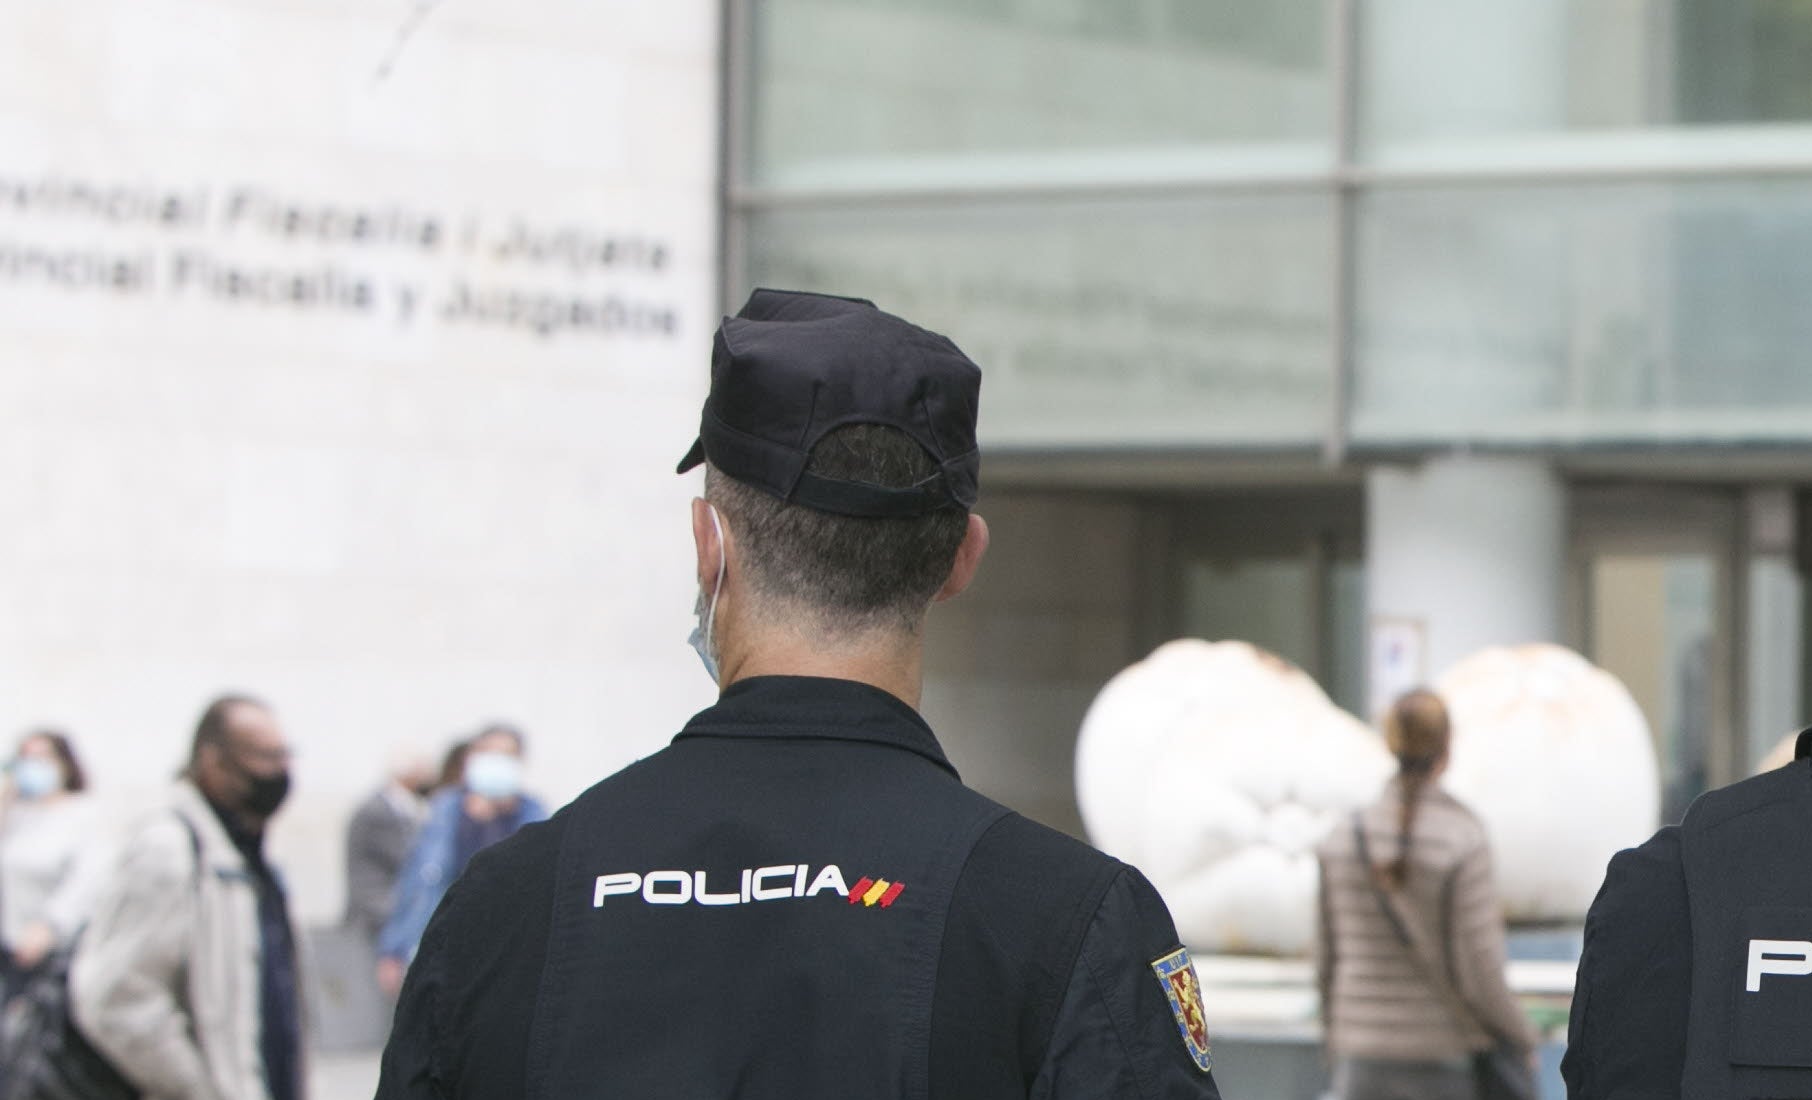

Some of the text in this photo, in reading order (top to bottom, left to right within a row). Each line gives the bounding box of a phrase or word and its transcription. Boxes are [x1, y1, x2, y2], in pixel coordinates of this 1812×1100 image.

[227, 183, 448, 250] Fiscalia
[435, 274, 681, 343] Juzgados
[593, 863, 850, 907] POLICIA
